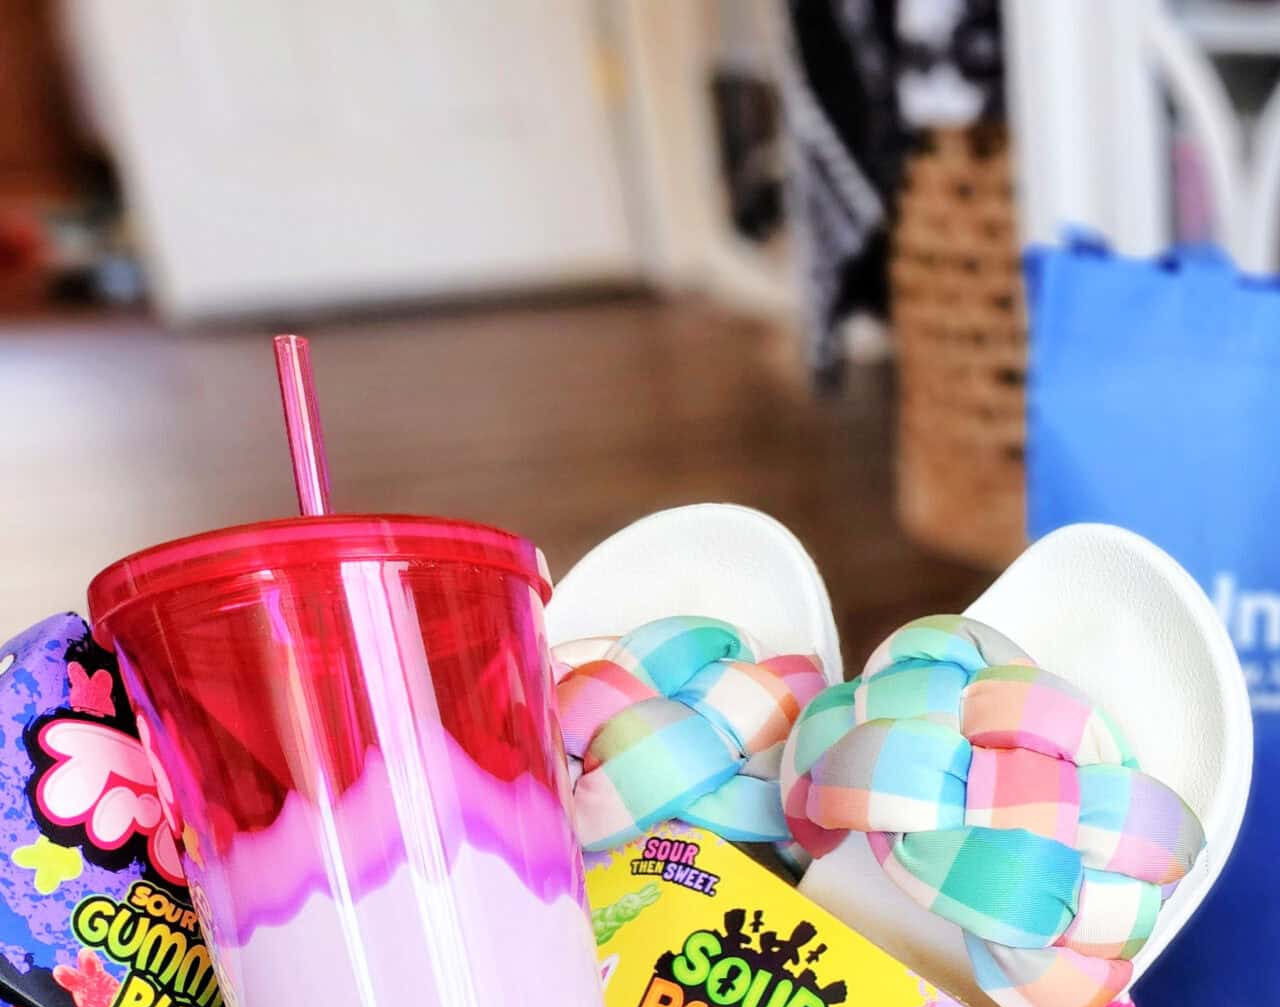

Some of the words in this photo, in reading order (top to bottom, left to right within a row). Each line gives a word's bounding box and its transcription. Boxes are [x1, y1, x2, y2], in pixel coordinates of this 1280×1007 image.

[643, 838, 699, 866] SOUR
[631, 860, 665, 875] THEN
[131, 885, 198, 932] SOUR
